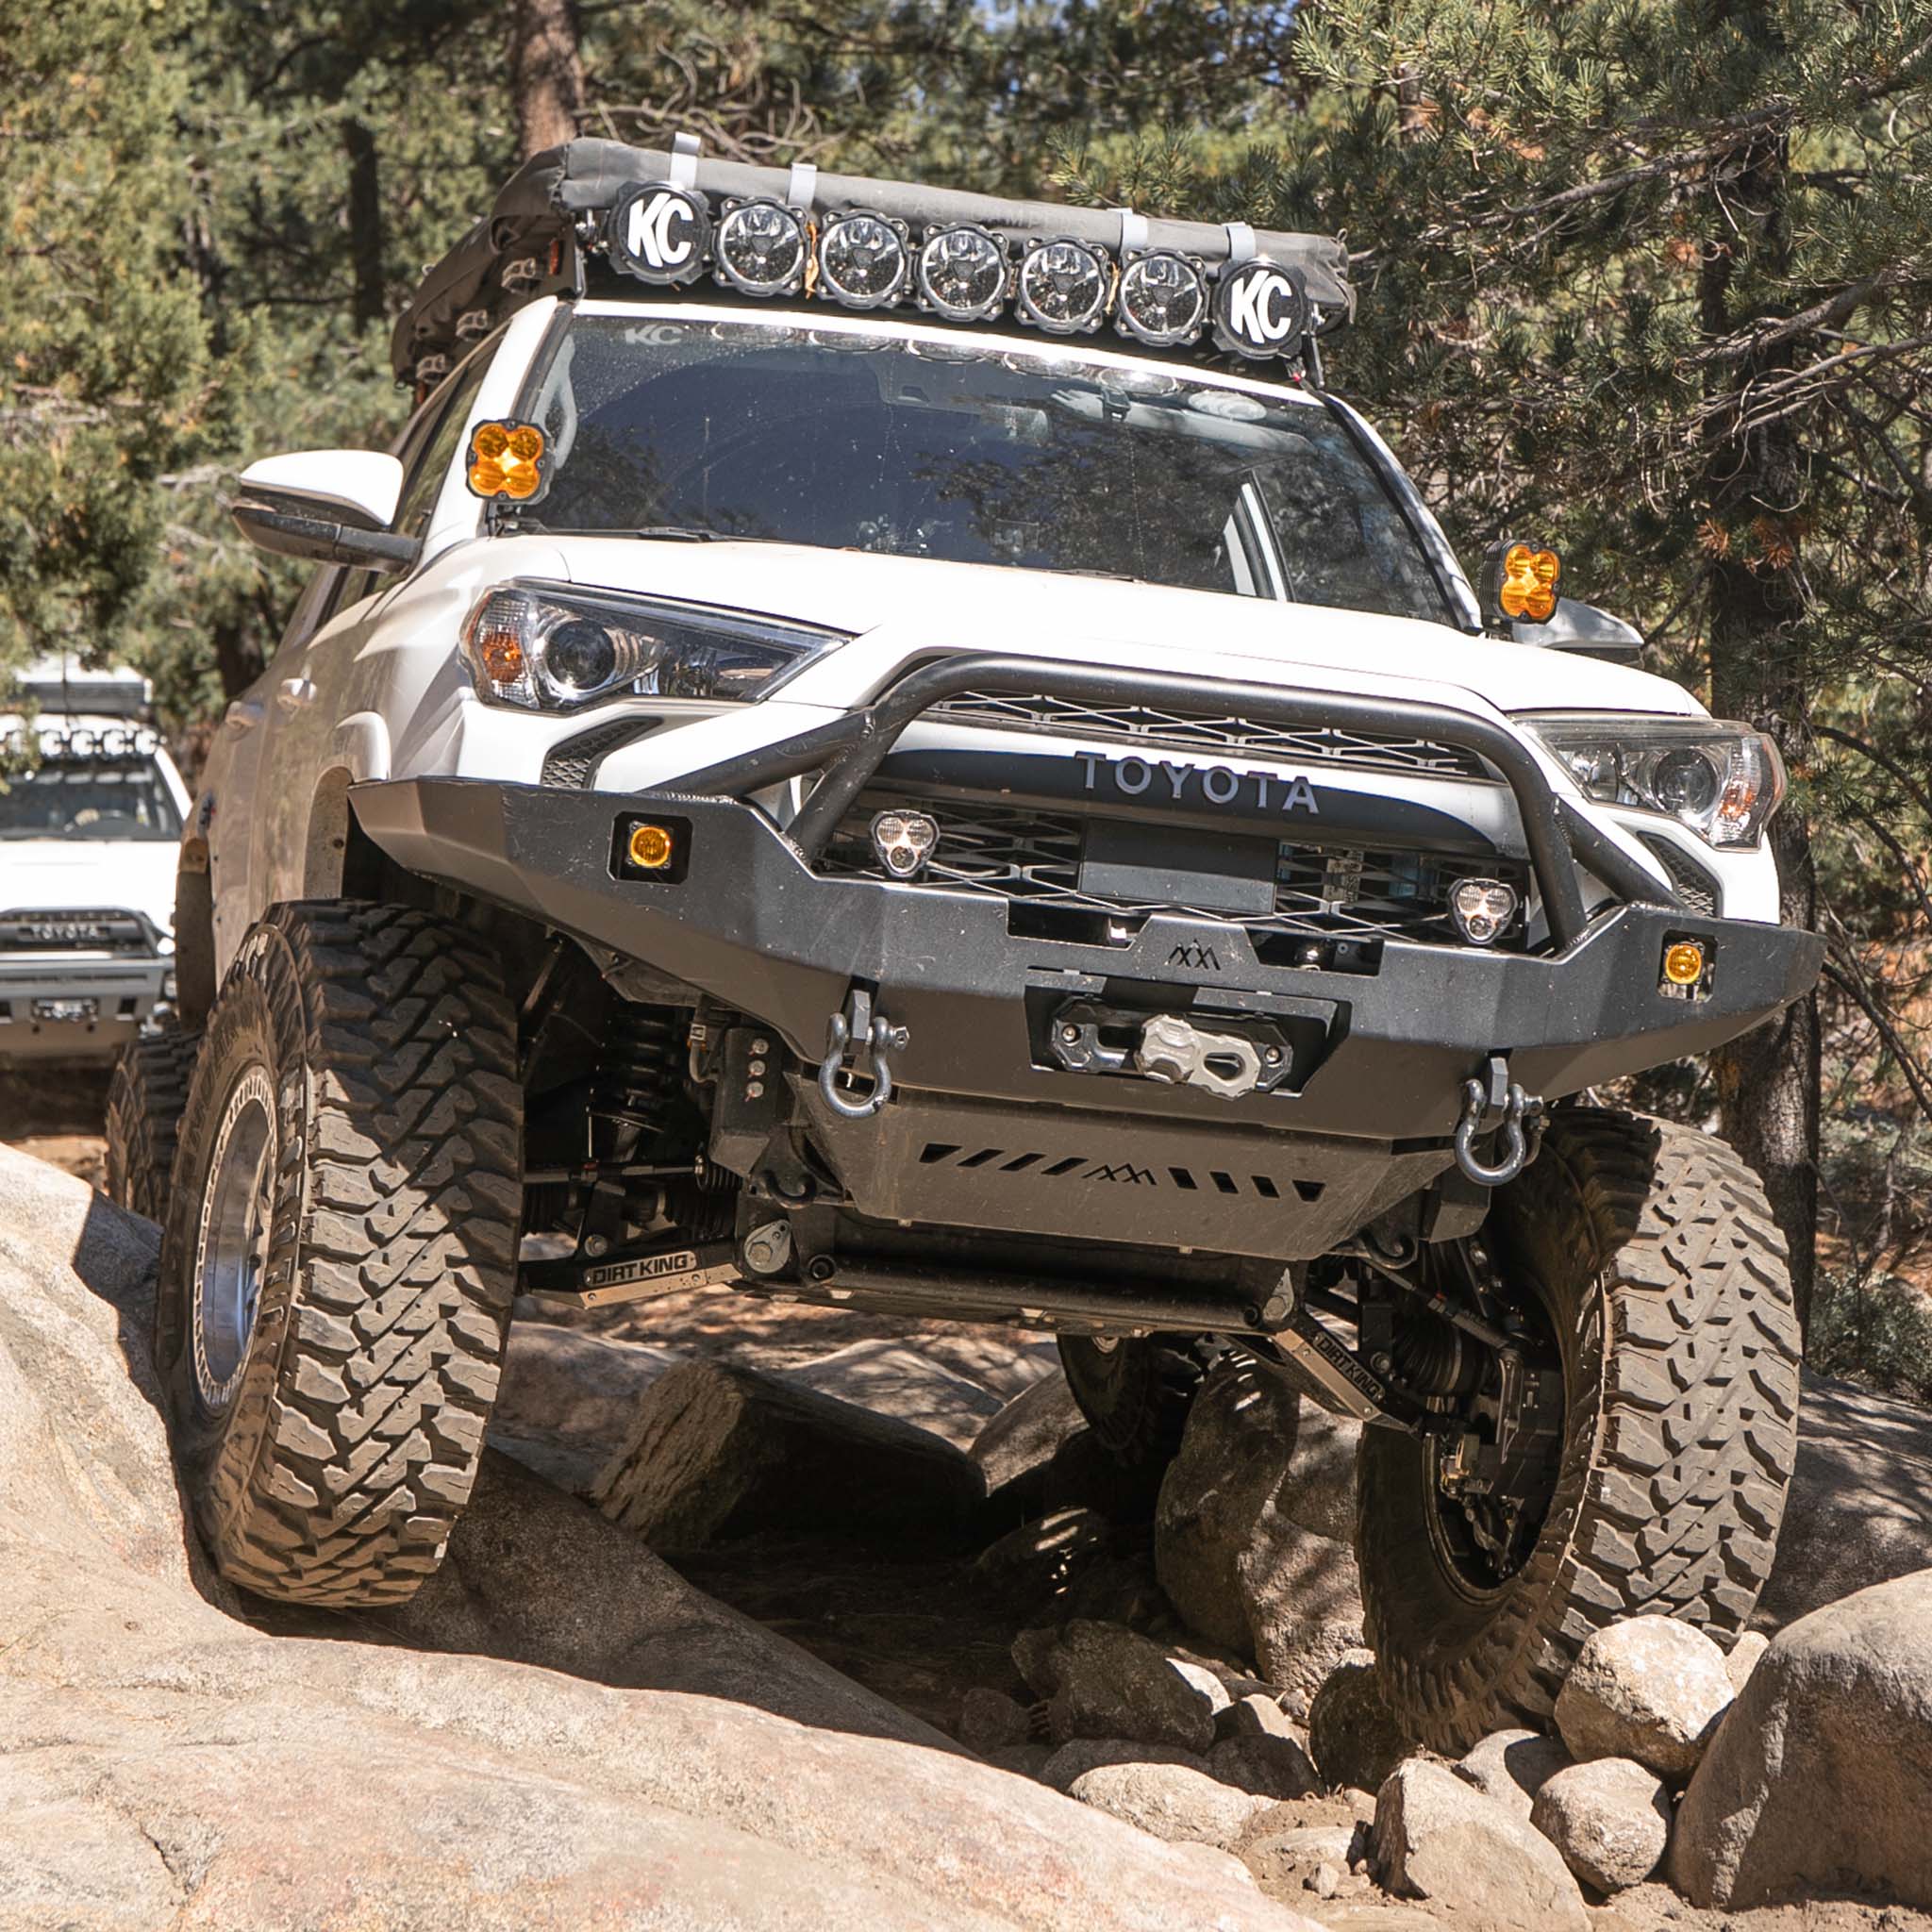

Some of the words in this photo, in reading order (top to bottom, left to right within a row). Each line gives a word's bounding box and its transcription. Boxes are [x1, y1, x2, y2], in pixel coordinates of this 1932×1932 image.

[627, 192, 693, 268] KC
[1230, 270, 1292, 344] KC
[1074, 751, 1319, 814] TOYOTA
[593, 1263, 639, 1284] DIRT
[641, 1255, 688, 1274] KING
[1318, 1338, 1350, 1368] DIRT
[1350, 1364, 1380, 1397] KING
